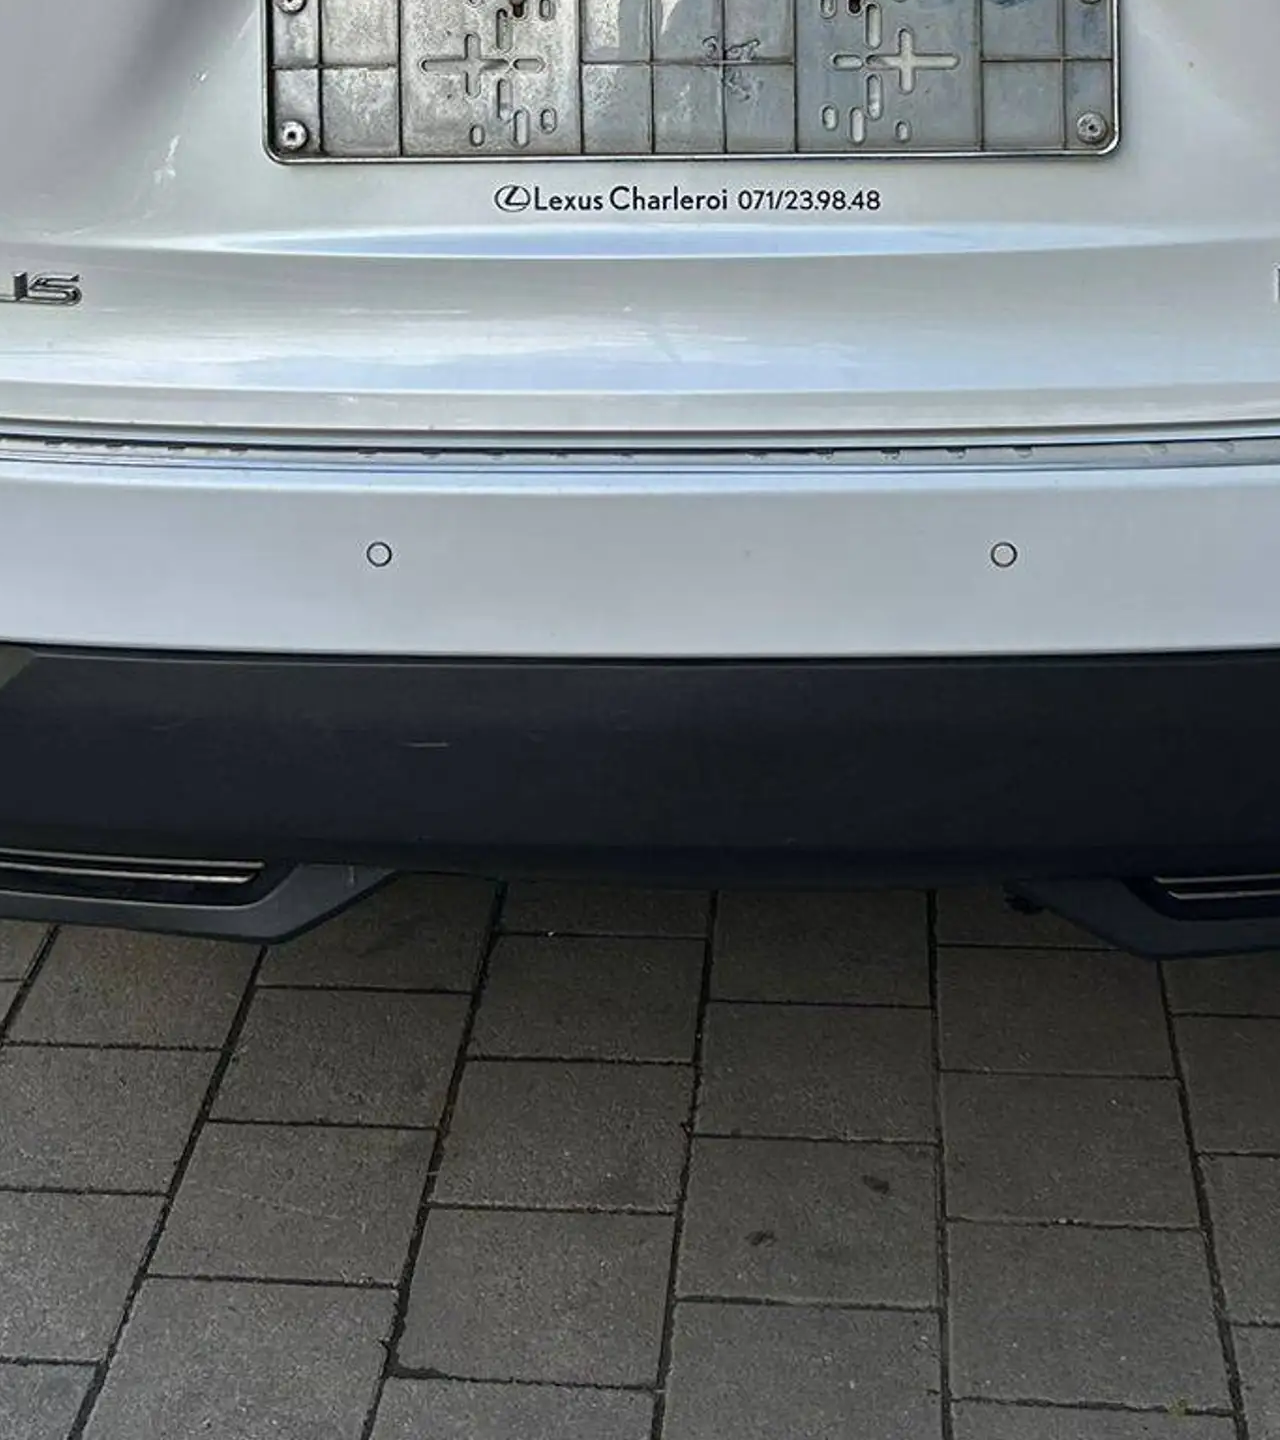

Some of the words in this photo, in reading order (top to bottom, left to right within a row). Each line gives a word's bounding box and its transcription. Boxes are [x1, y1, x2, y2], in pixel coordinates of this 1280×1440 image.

[534, 187, 603, 211] Lexus
[610, 186, 728, 211] Charleroi
[737, 190, 881, 211] 071/23.98.48
